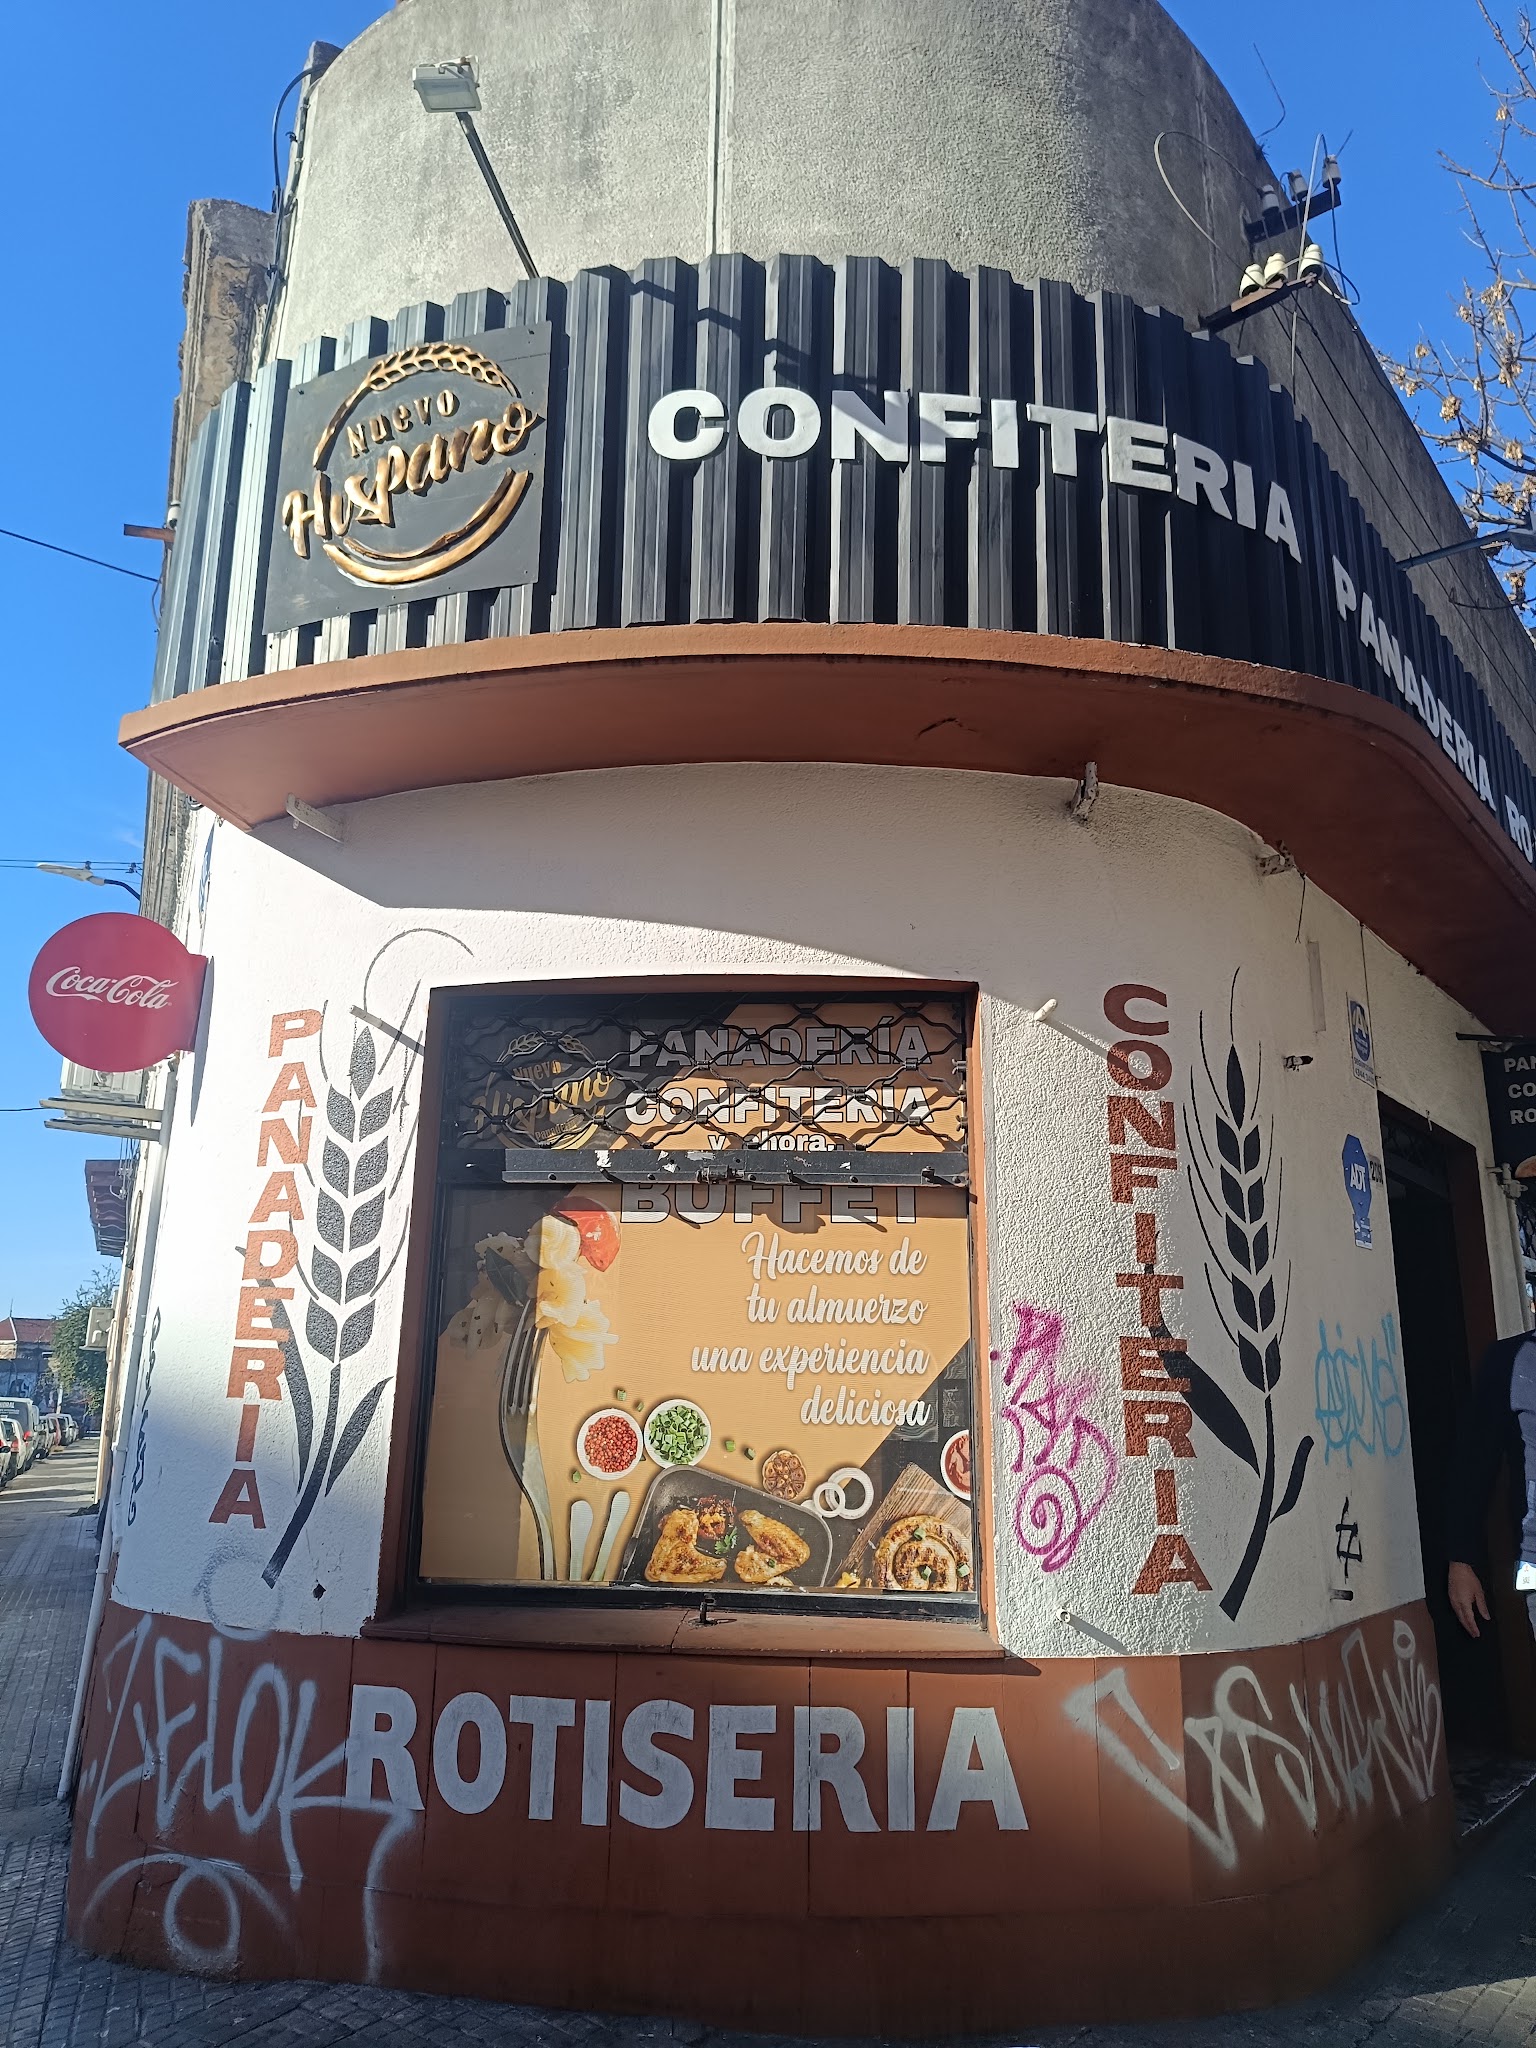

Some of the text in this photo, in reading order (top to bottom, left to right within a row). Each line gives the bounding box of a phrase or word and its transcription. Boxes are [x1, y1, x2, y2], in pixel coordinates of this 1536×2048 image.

[648, 387, 1301, 564] CONFITERIA
[1333, 554, 1536, 864] PANADERIA RO
[45, 966, 180, 1009] Coca-Cola
[628, 1015, 933, 1068] PANADERÍA
[624, 1077, 935, 1125] CONFITERÍA
[1350, 1163, 1367, 1192] ADT
[208, 1008, 324, 1529] PANADERIA
[741, 1231, 928, 1280] Hacemos de
[746, 1282, 929, 1325] tu almuerzo
[1102, 982, 1213, 1595] CONFITERIA
[691, 1338, 930, 1390] una experiencia
[800, 1385, 931, 1427] deliciosa
[344, 1683, 1030, 1833] ROTISERIA
